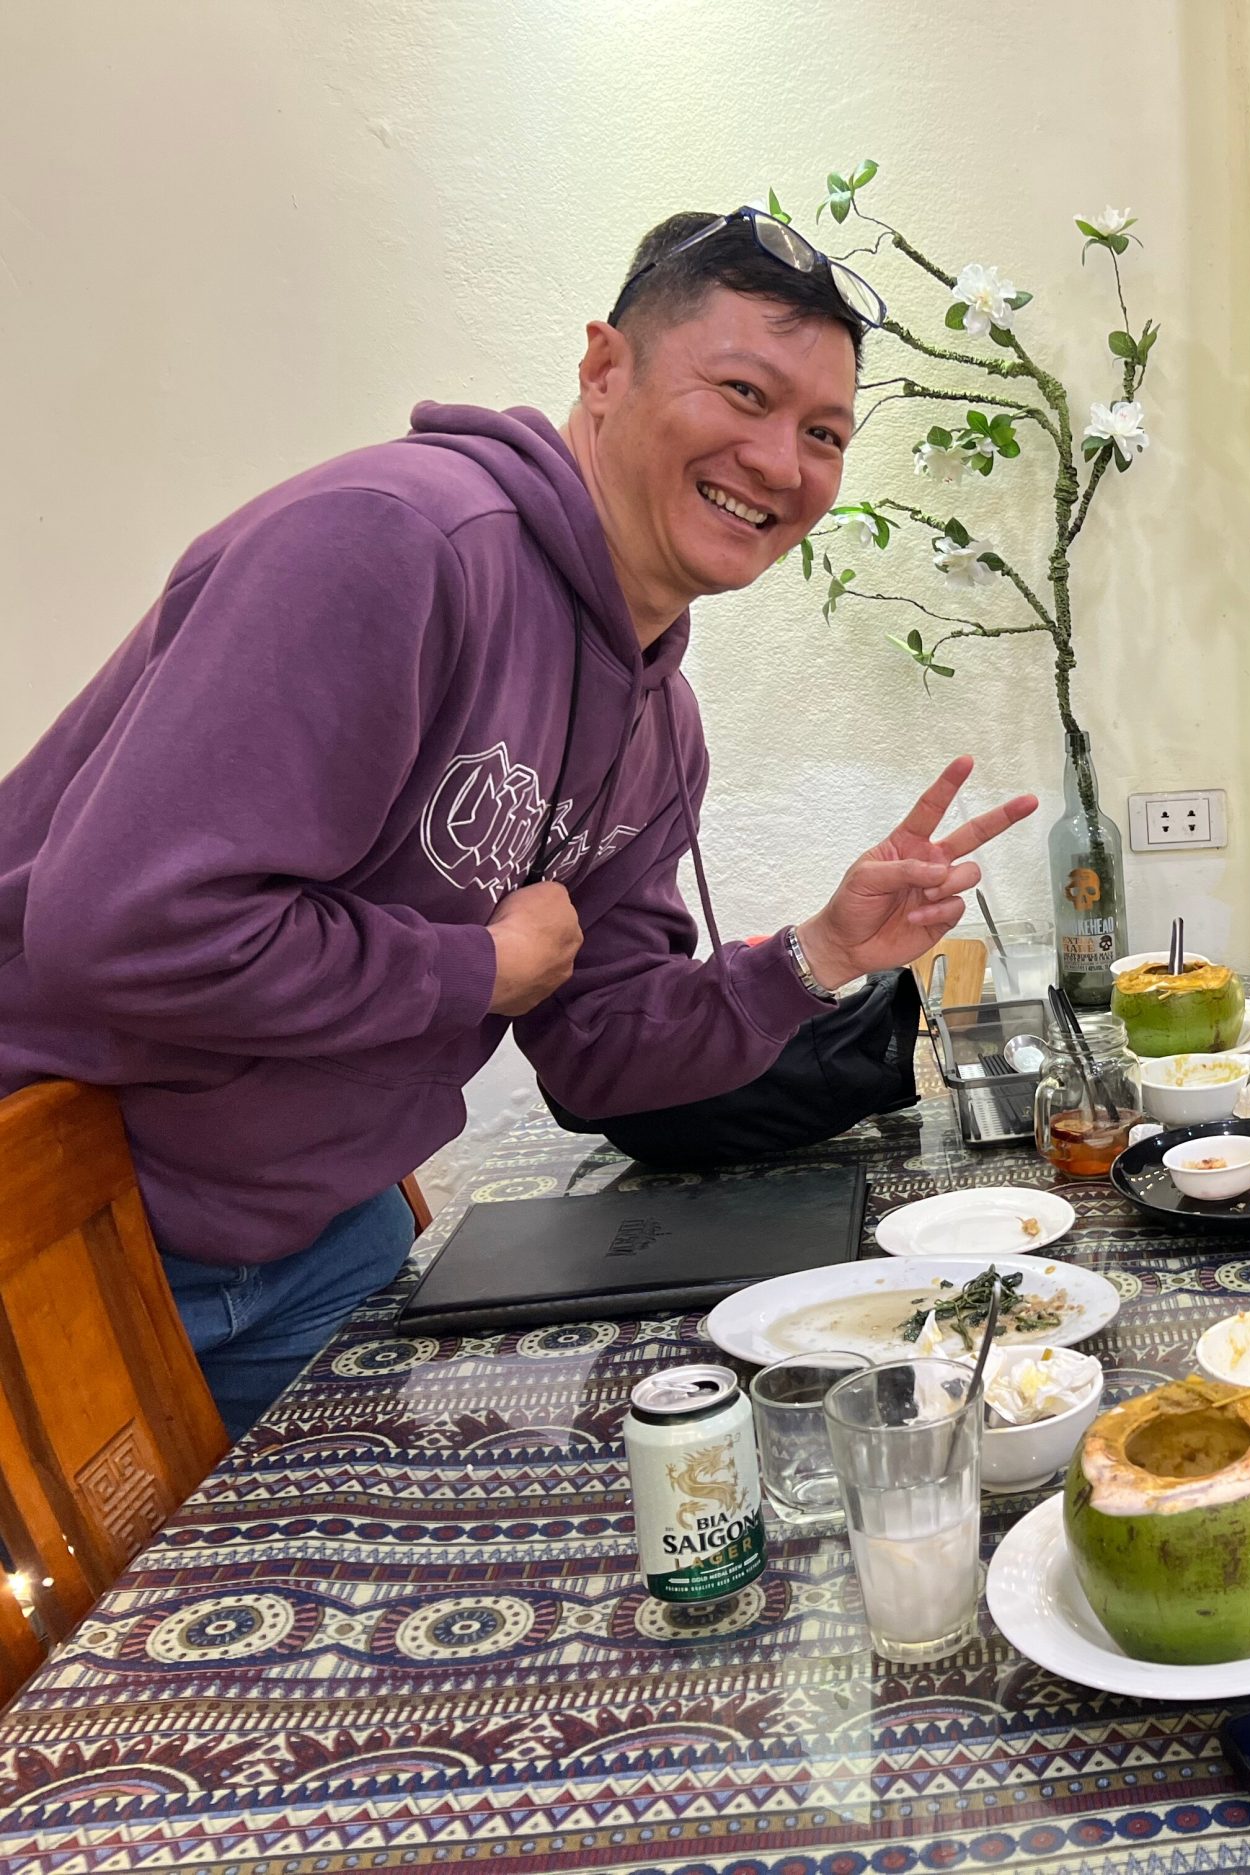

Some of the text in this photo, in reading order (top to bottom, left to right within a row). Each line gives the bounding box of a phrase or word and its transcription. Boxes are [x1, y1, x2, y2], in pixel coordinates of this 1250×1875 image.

[662, 1508, 758, 1555] SAIGON
[697, 1512, 729, 1531] BIA
[674, 1537, 753, 1570] LAGER
[709, 1571, 729, 1580] MEDAL
